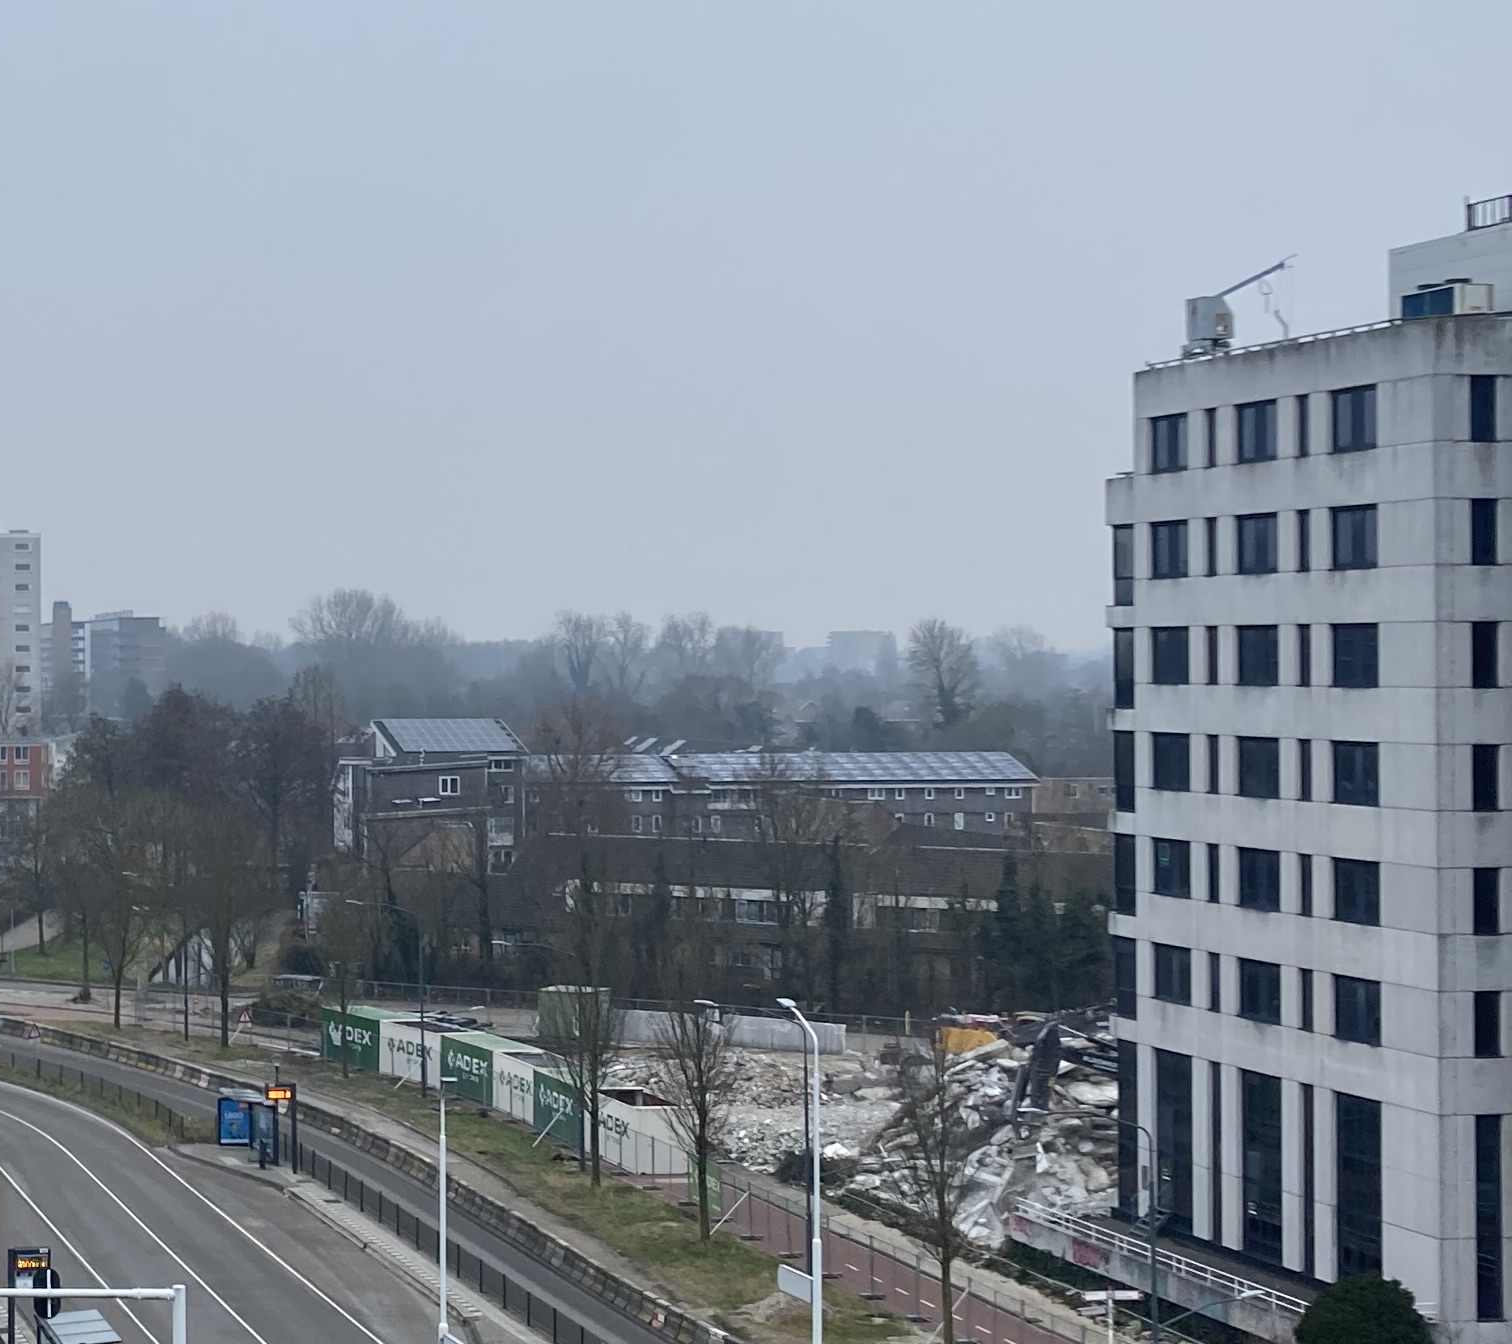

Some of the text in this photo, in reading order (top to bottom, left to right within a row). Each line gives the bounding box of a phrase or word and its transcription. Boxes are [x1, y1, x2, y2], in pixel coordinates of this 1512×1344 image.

[396, 1039, 433, 1061] ADEX
[455, 1053, 489, 1077] ADEX
[505, 1072, 533, 1096] ADEX
[545, 1088, 574, 1116] ADEX
